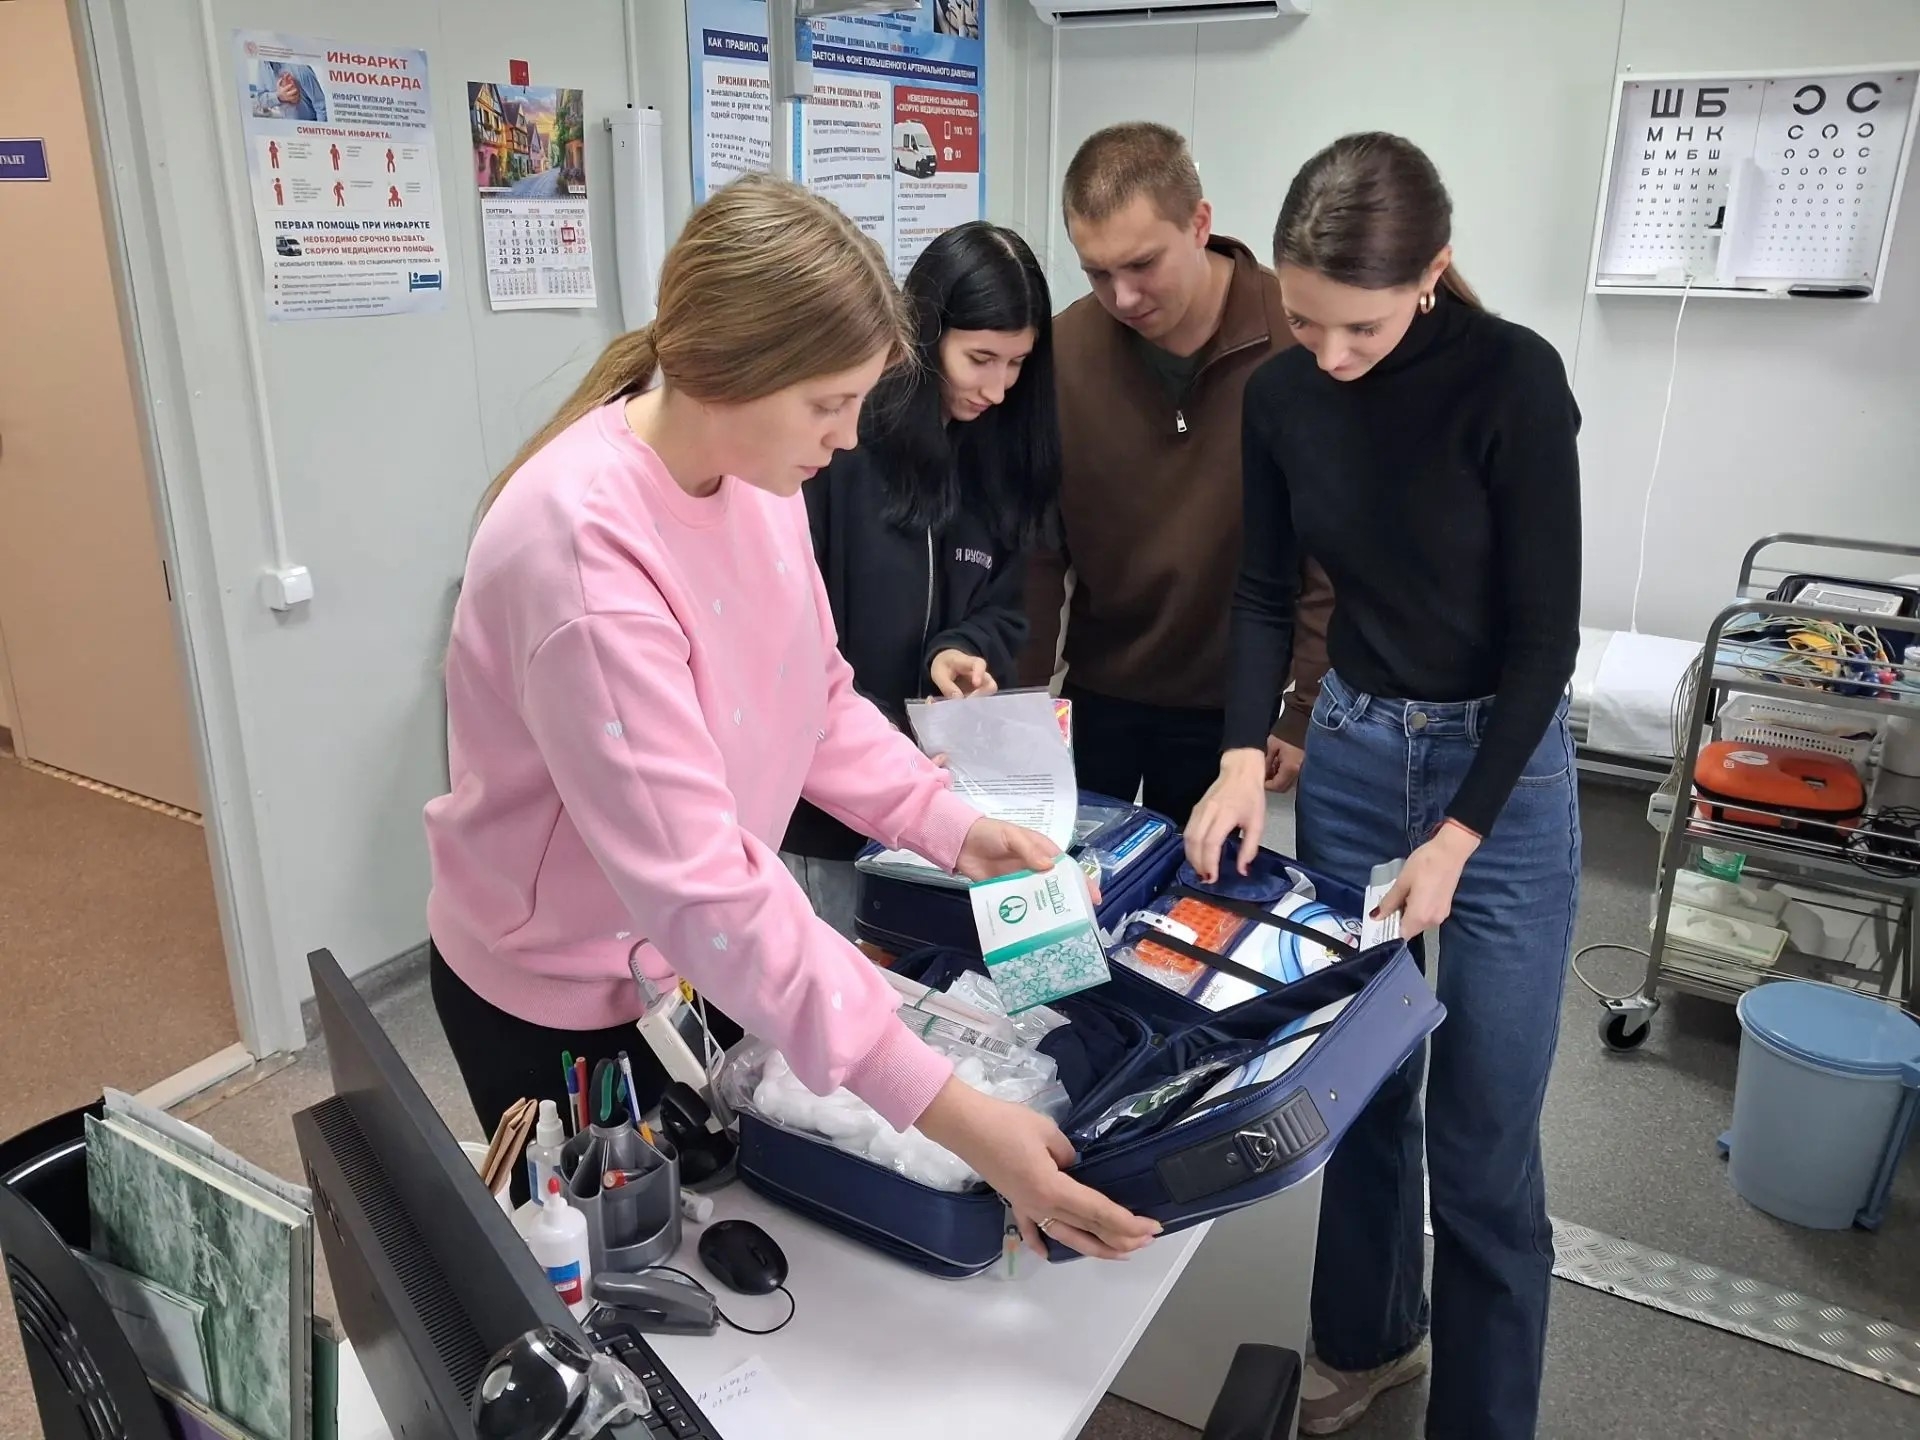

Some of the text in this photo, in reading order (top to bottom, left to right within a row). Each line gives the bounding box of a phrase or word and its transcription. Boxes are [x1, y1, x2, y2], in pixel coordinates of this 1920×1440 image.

[707, 36, 723, 48] КАК
[725, 38, 760, 54] ПРАВИЛО,
[327, 51, 408, 70] ИНФАРКТ
[812, 49, 836, 61] ВАЕТСЯ
[836, 53, 845, 63] НА
[846, 55, 863, 66] ФОНЕ
[863, 56, 907, 71] ПОВЫШЕННОГО
[907, 62, 950, 77] АРТЕРИАЛЬНОГО
[329, 70, 421, 90] МИОКАРДА
[717, 74, 770, 89] ПРИЗНАКИ ИНСУЛЬ
[1650, 87, 1730, 118] Ш Б
[296, 126, 392, 139] СИМПТОМЫ ИНФАРКТА:
[1646, 125, 1724, 142] М Н К
[749, 148, 770, 159] наруш
[1643, 149, 1720, 160] Ы М Б Ш
[1641, 167, 1718, 176] Б Ы Н К М
[274, 220, 431, 231] ПЕРВАЯ ПОМОЩЬ ПРИ ИНФАРКТЕ
[303, 235, 358, 244] НЕОБХОДИМО
[359, 235, 390, 243] СРОЧНО
[305, 245, 435, 255] СКОРУЮ МЕДИЦИНСКУЮ ПОМОЩЬ
[512, 257, 521, 265] 29
[955, 548, 962, 561] Я
